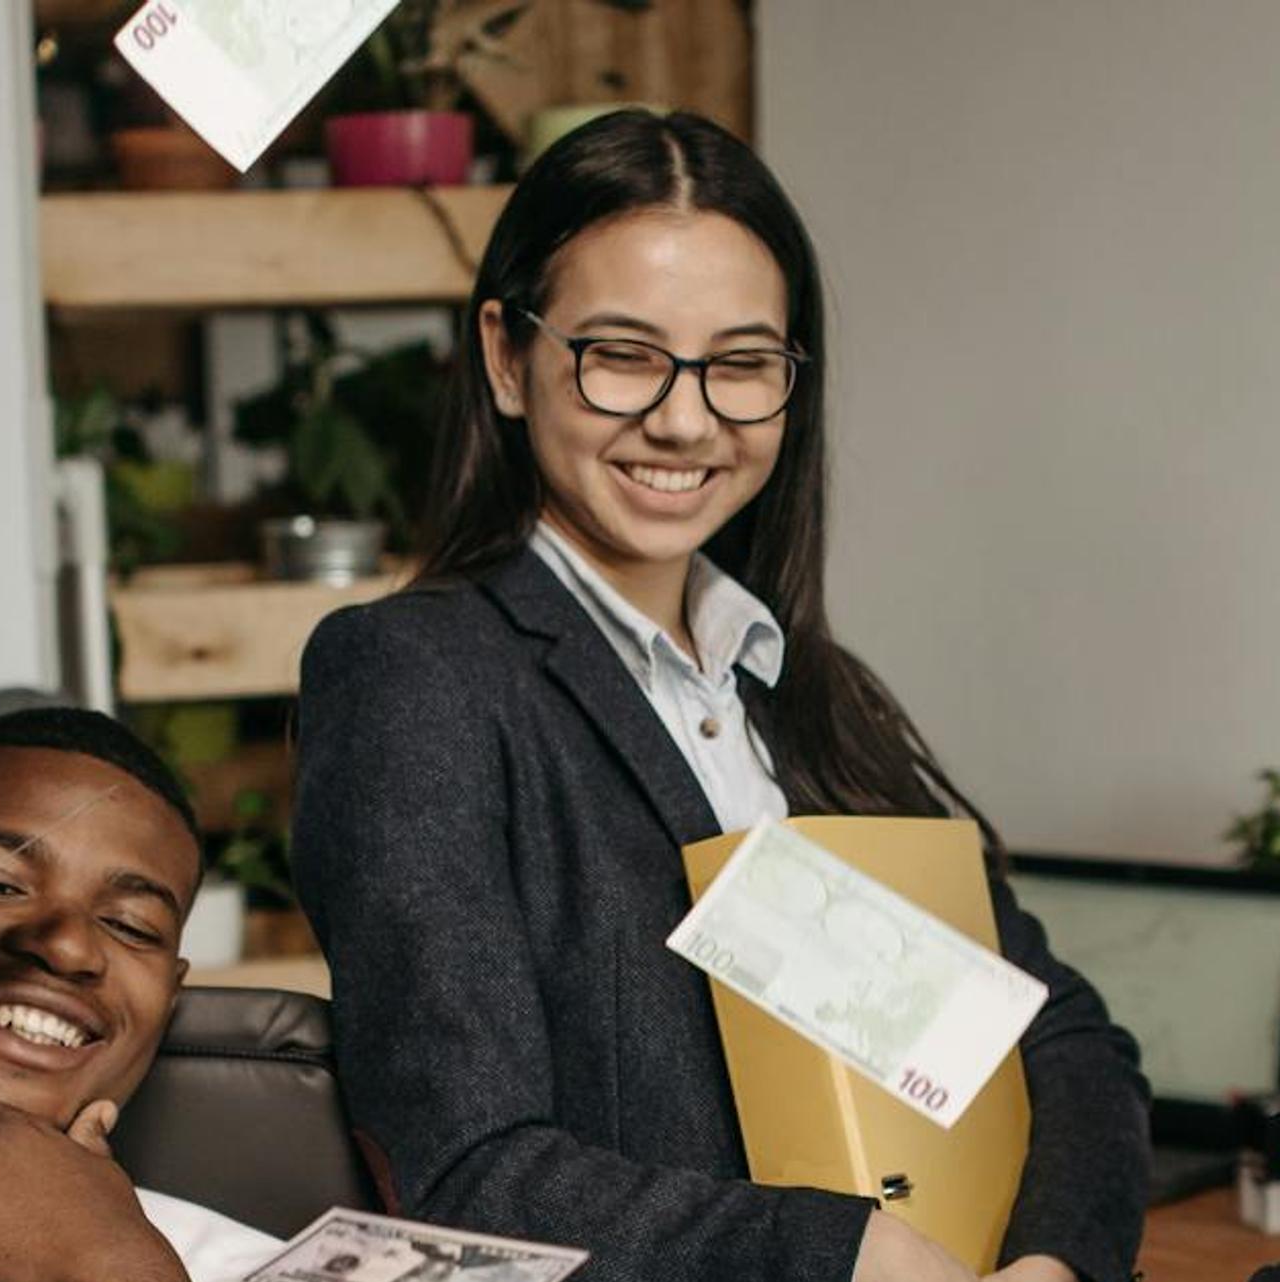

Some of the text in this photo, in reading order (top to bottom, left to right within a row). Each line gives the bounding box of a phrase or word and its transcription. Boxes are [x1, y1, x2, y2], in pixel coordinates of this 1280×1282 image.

[132, 3, 177, 50] 100
[684, 933, 733, 970] 100
[898, 1067, 949, 1112] 100
